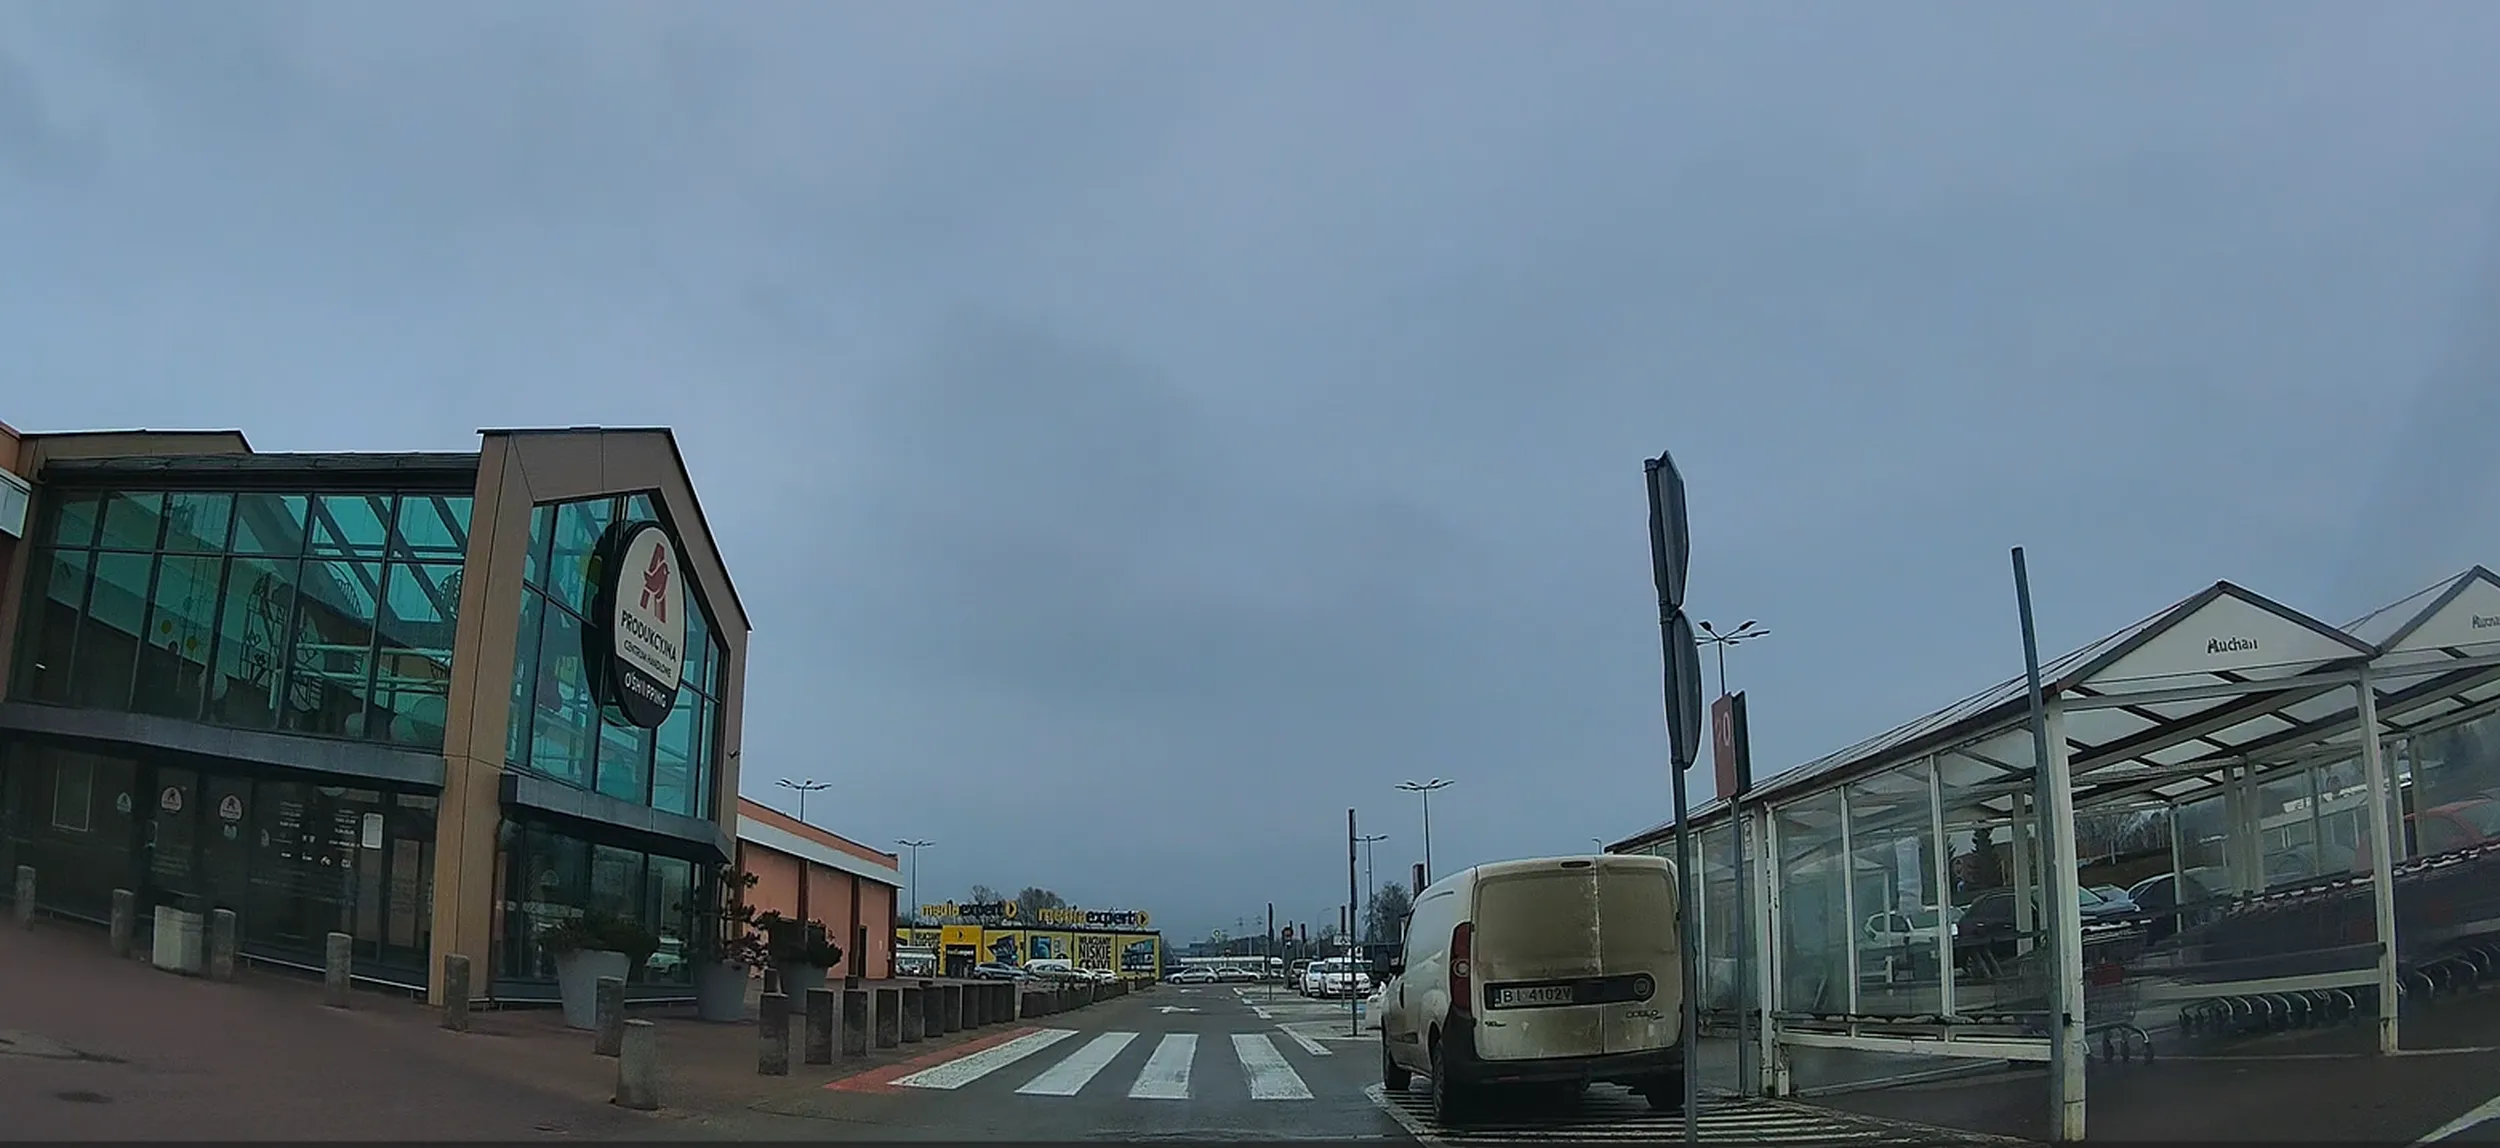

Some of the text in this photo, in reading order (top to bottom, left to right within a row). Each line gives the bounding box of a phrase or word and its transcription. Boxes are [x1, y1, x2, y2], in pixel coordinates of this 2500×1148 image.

[620, 610, 676, 662] PRODUKCYJNA
[2207, 637, 2258, 654] Auchan
[1078, 945, 1112, 959] NISKIE
[1528, 987, 1571, 1001] 4102V
